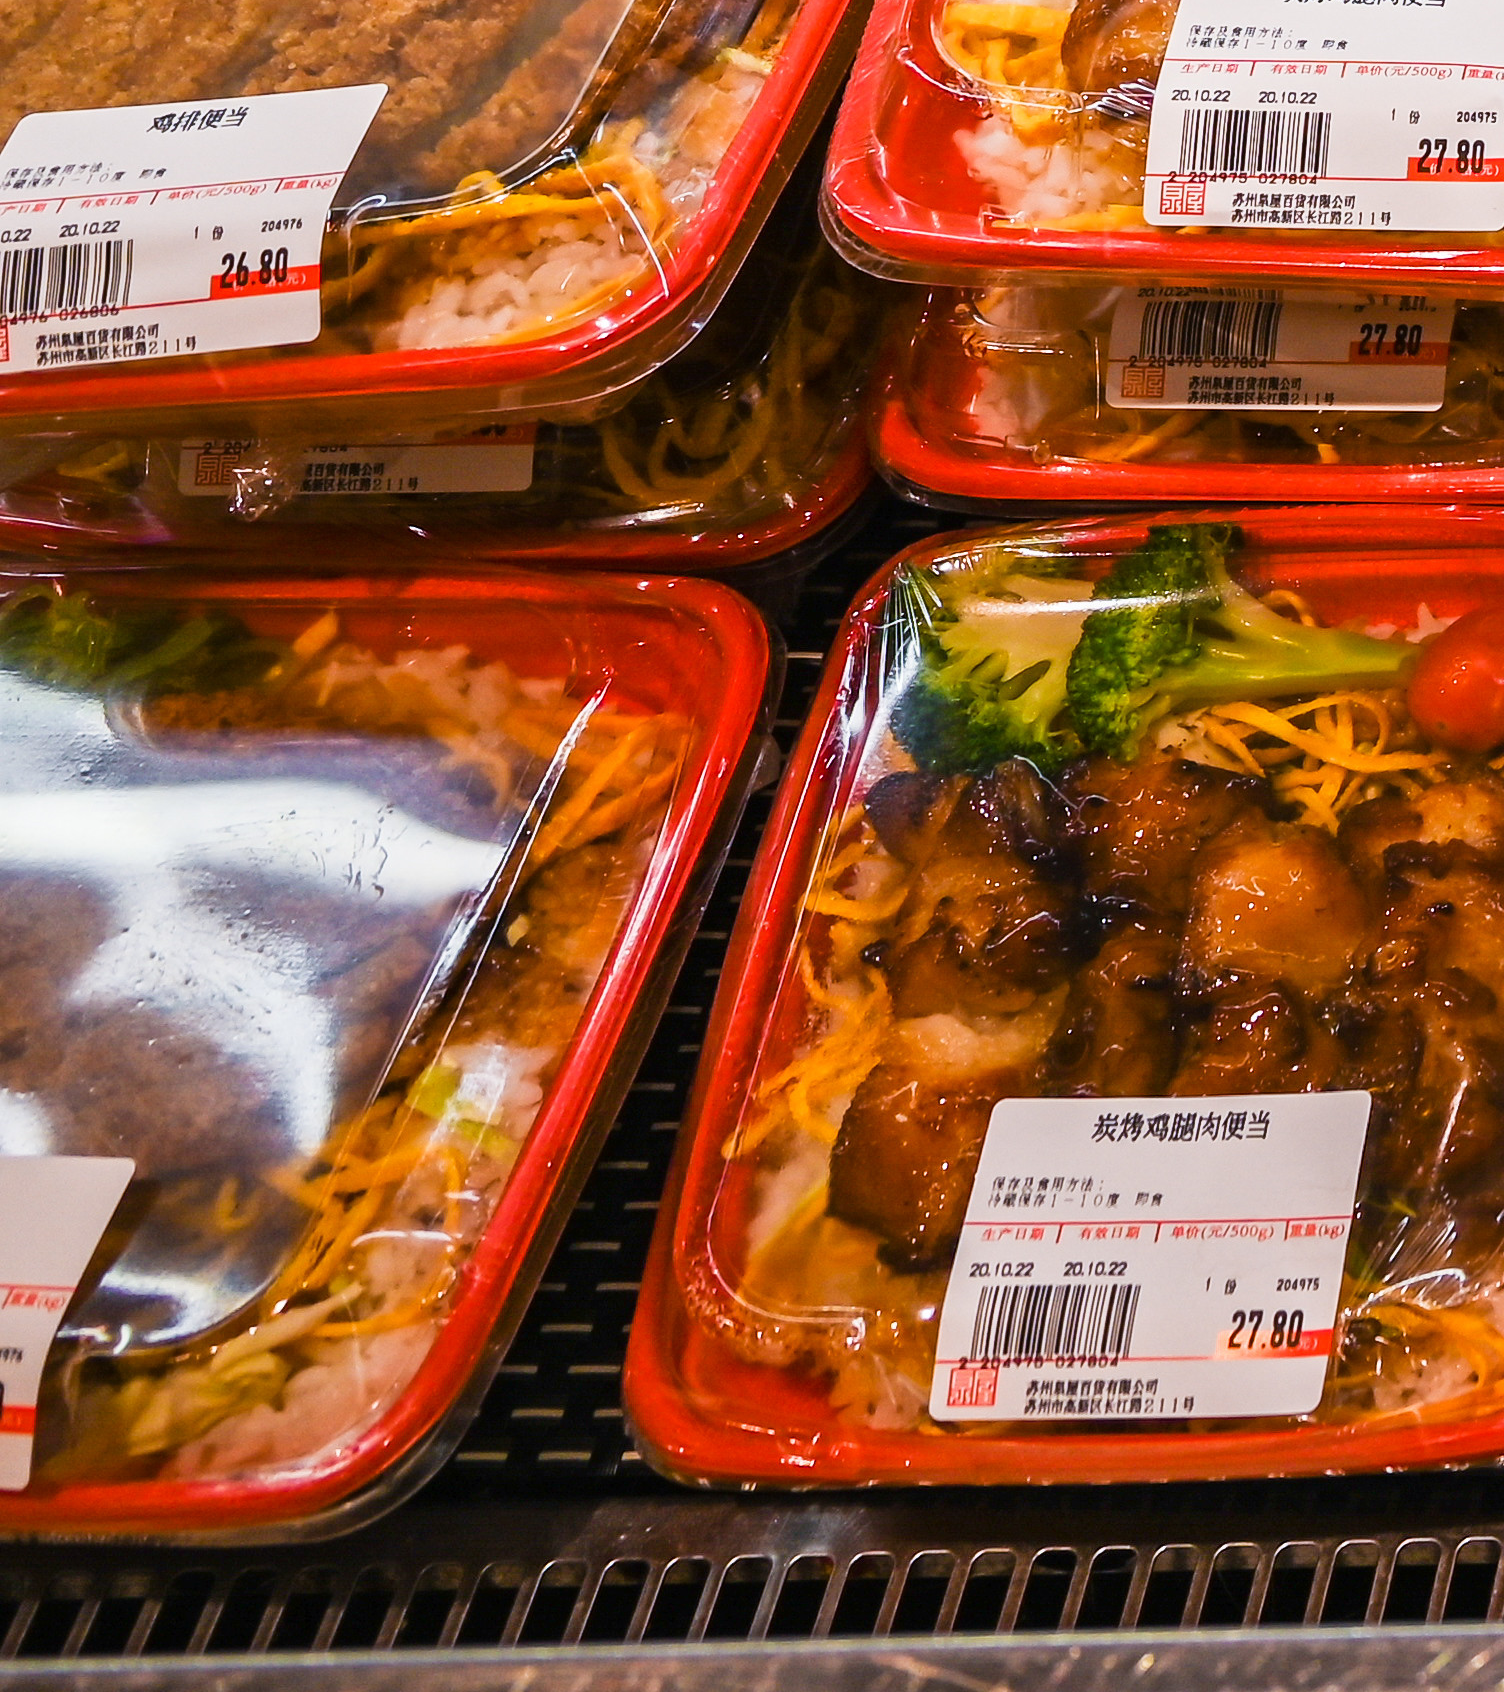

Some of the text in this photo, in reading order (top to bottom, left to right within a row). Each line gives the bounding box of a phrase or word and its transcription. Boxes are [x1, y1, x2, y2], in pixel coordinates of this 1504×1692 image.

[1181, 62, 1239, 74] 生产日期
[1271, 63, 1328, 76] 有效日期
[1171, 89, 1317, 104] 20.10.22 20.10.22
[146, 106, 250, 133] 鸡排便当
[1457, 111, 1497, 124] 204975
[1417, 138, 1484, 175] 27.80
[59, 220, 121, 238] 20.10.22
[261, 217, 302, 232] 204976
[220, 247, 289, 290] 26.80
[1358, 323, 1422, 356] 27.80
[1091, 1110, 1270, 1143] 炭烤鸡腿肉便当
[969, 1261, 1128, 1278] 20.10.22 20.10.22
[1276, 1277, 1320, 1293] 204975
[1228, 1309, 1304, 1350] 27.80
